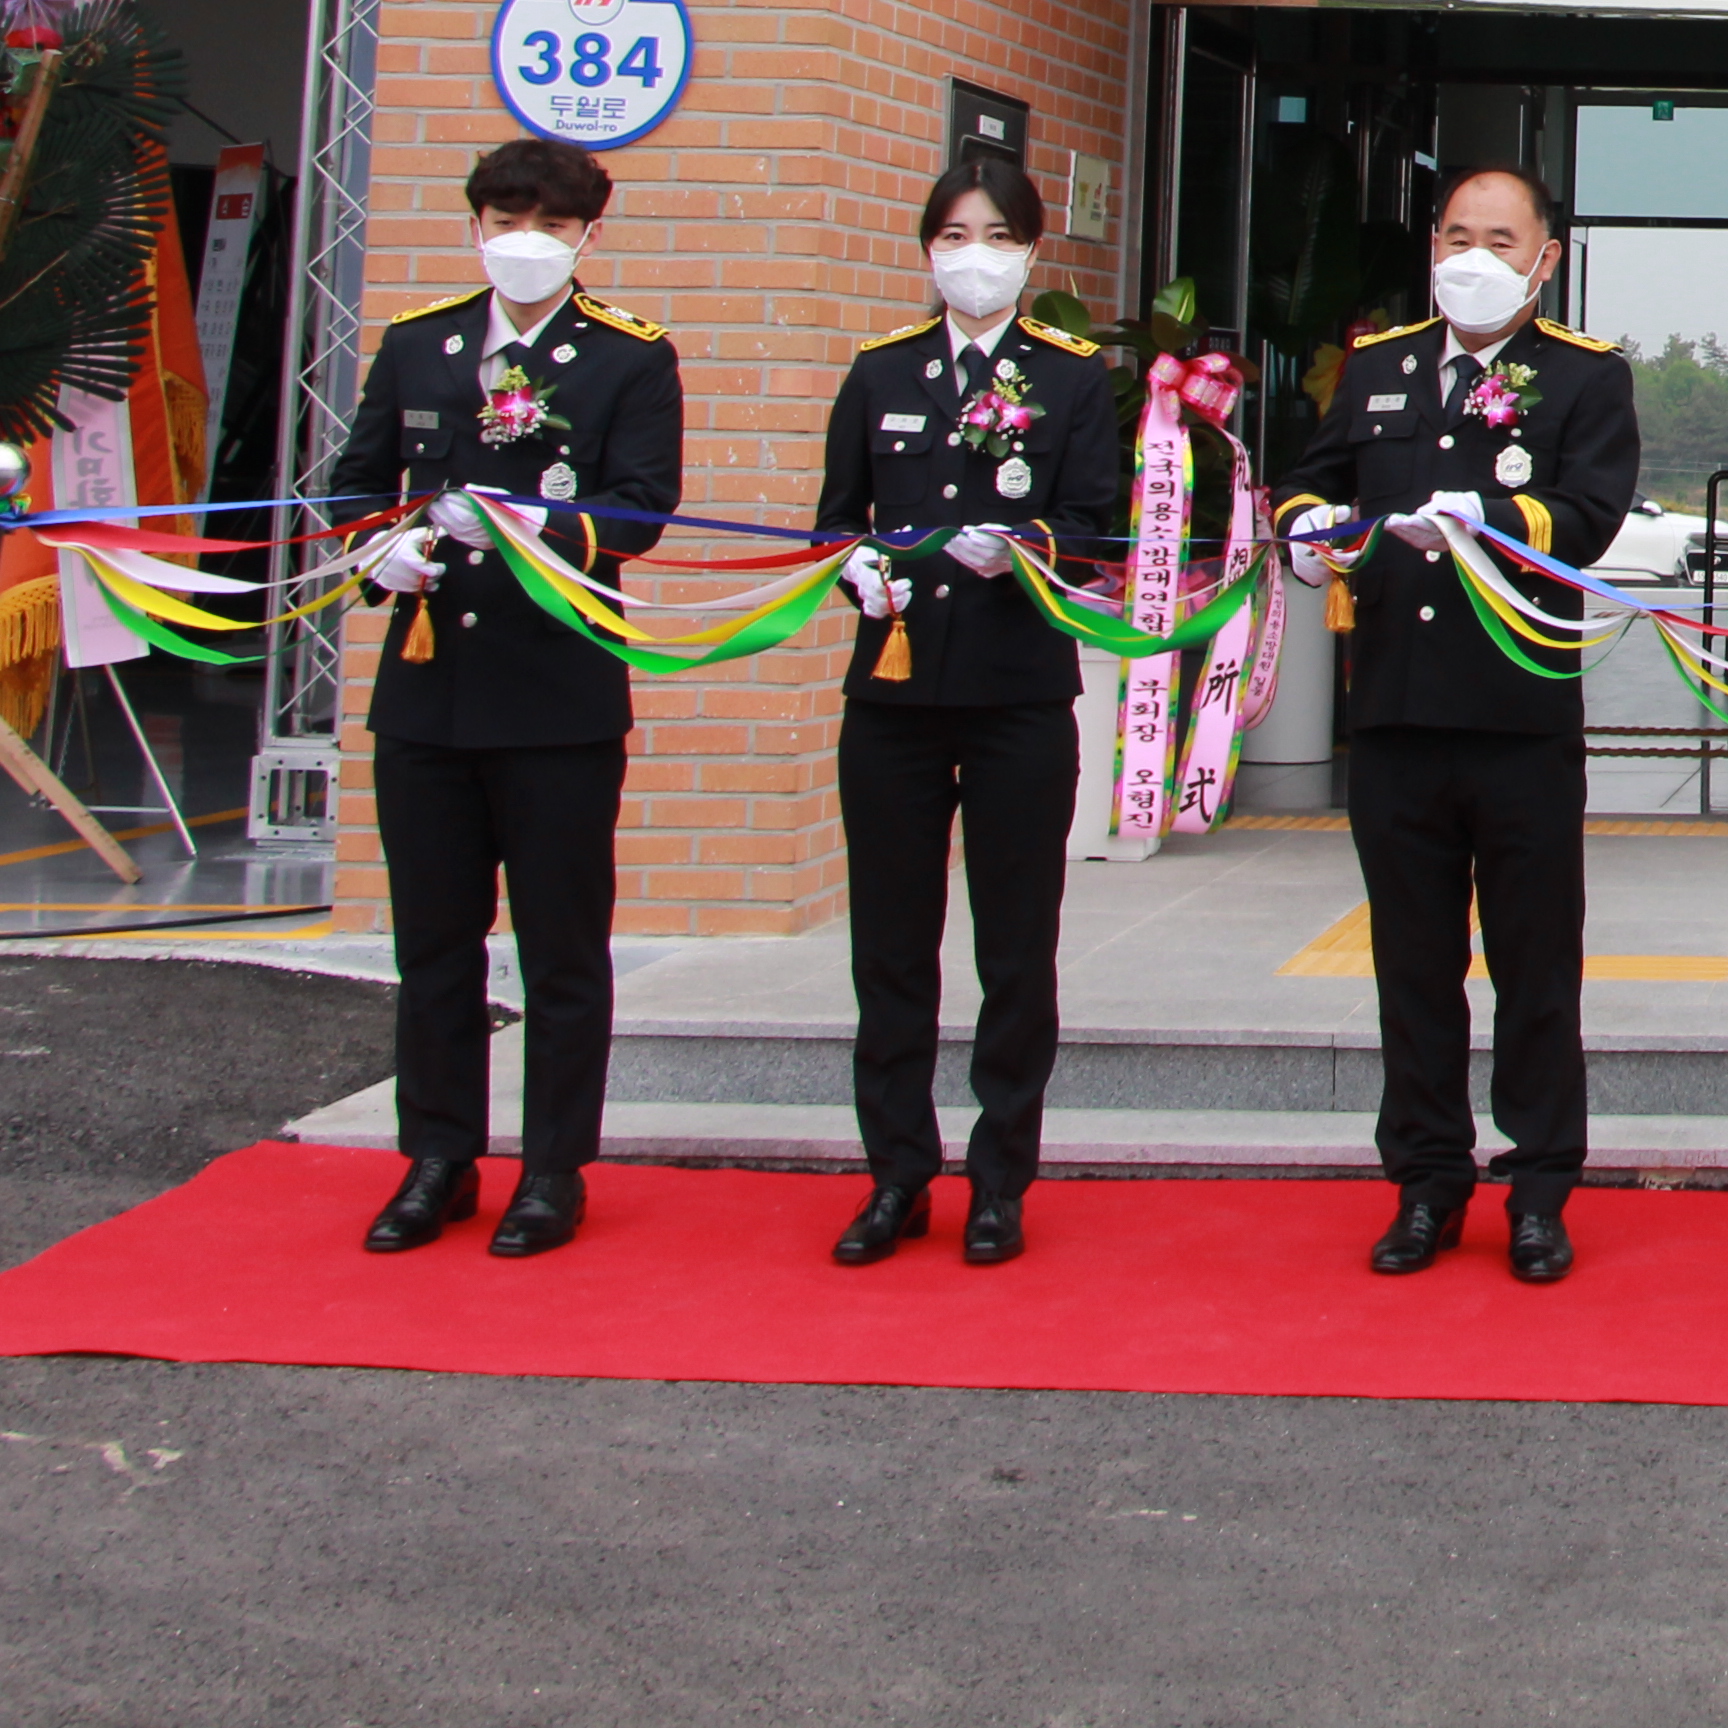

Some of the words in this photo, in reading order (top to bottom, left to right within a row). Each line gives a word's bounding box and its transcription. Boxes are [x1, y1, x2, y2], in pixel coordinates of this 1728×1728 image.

[517, 30, 663, 89] 384
[550, 95, 627, 119] 두월로
[555, 119, 618, 133] Duwol-ro
[1138, 440, 1182, 636] 전국의용소방대연합
[1129, 679, 1168, 743] 부회장
